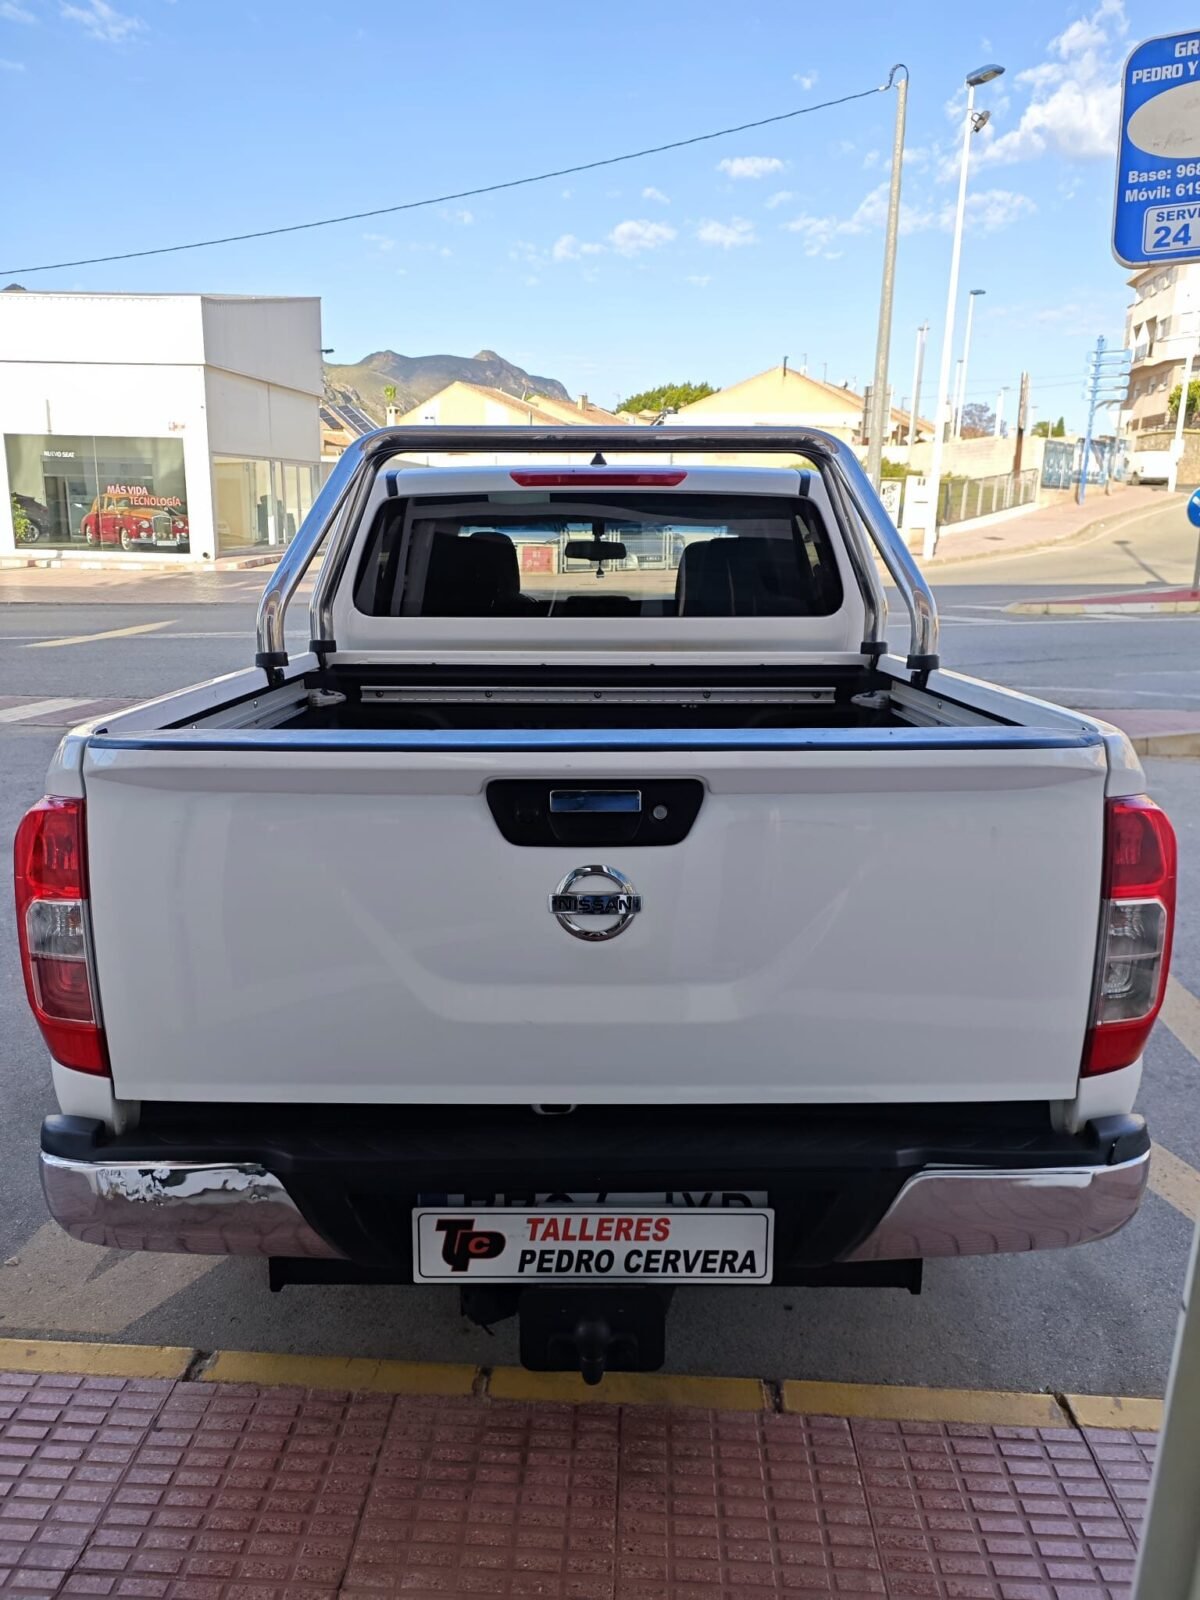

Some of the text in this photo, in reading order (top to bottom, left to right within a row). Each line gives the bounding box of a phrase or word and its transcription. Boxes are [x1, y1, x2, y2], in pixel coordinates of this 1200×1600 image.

[1132, 60, 1199, 85] PEDRO Y
[1127, 168, 1172, 184] Base:
[1124, 185, 1171, 203] Móvil:
[1152, 223, 1192, 249] 24
[106, 484, 148, 496] MÁS VIDA
[129, 495, 182, 507] TECNOLOGÍA
[558, 895, 632, 914] NISSAN
[526, 1217, 671, 1241] TALLERES
[517, 1249, 757, 1273] PEDRO CERVERA
